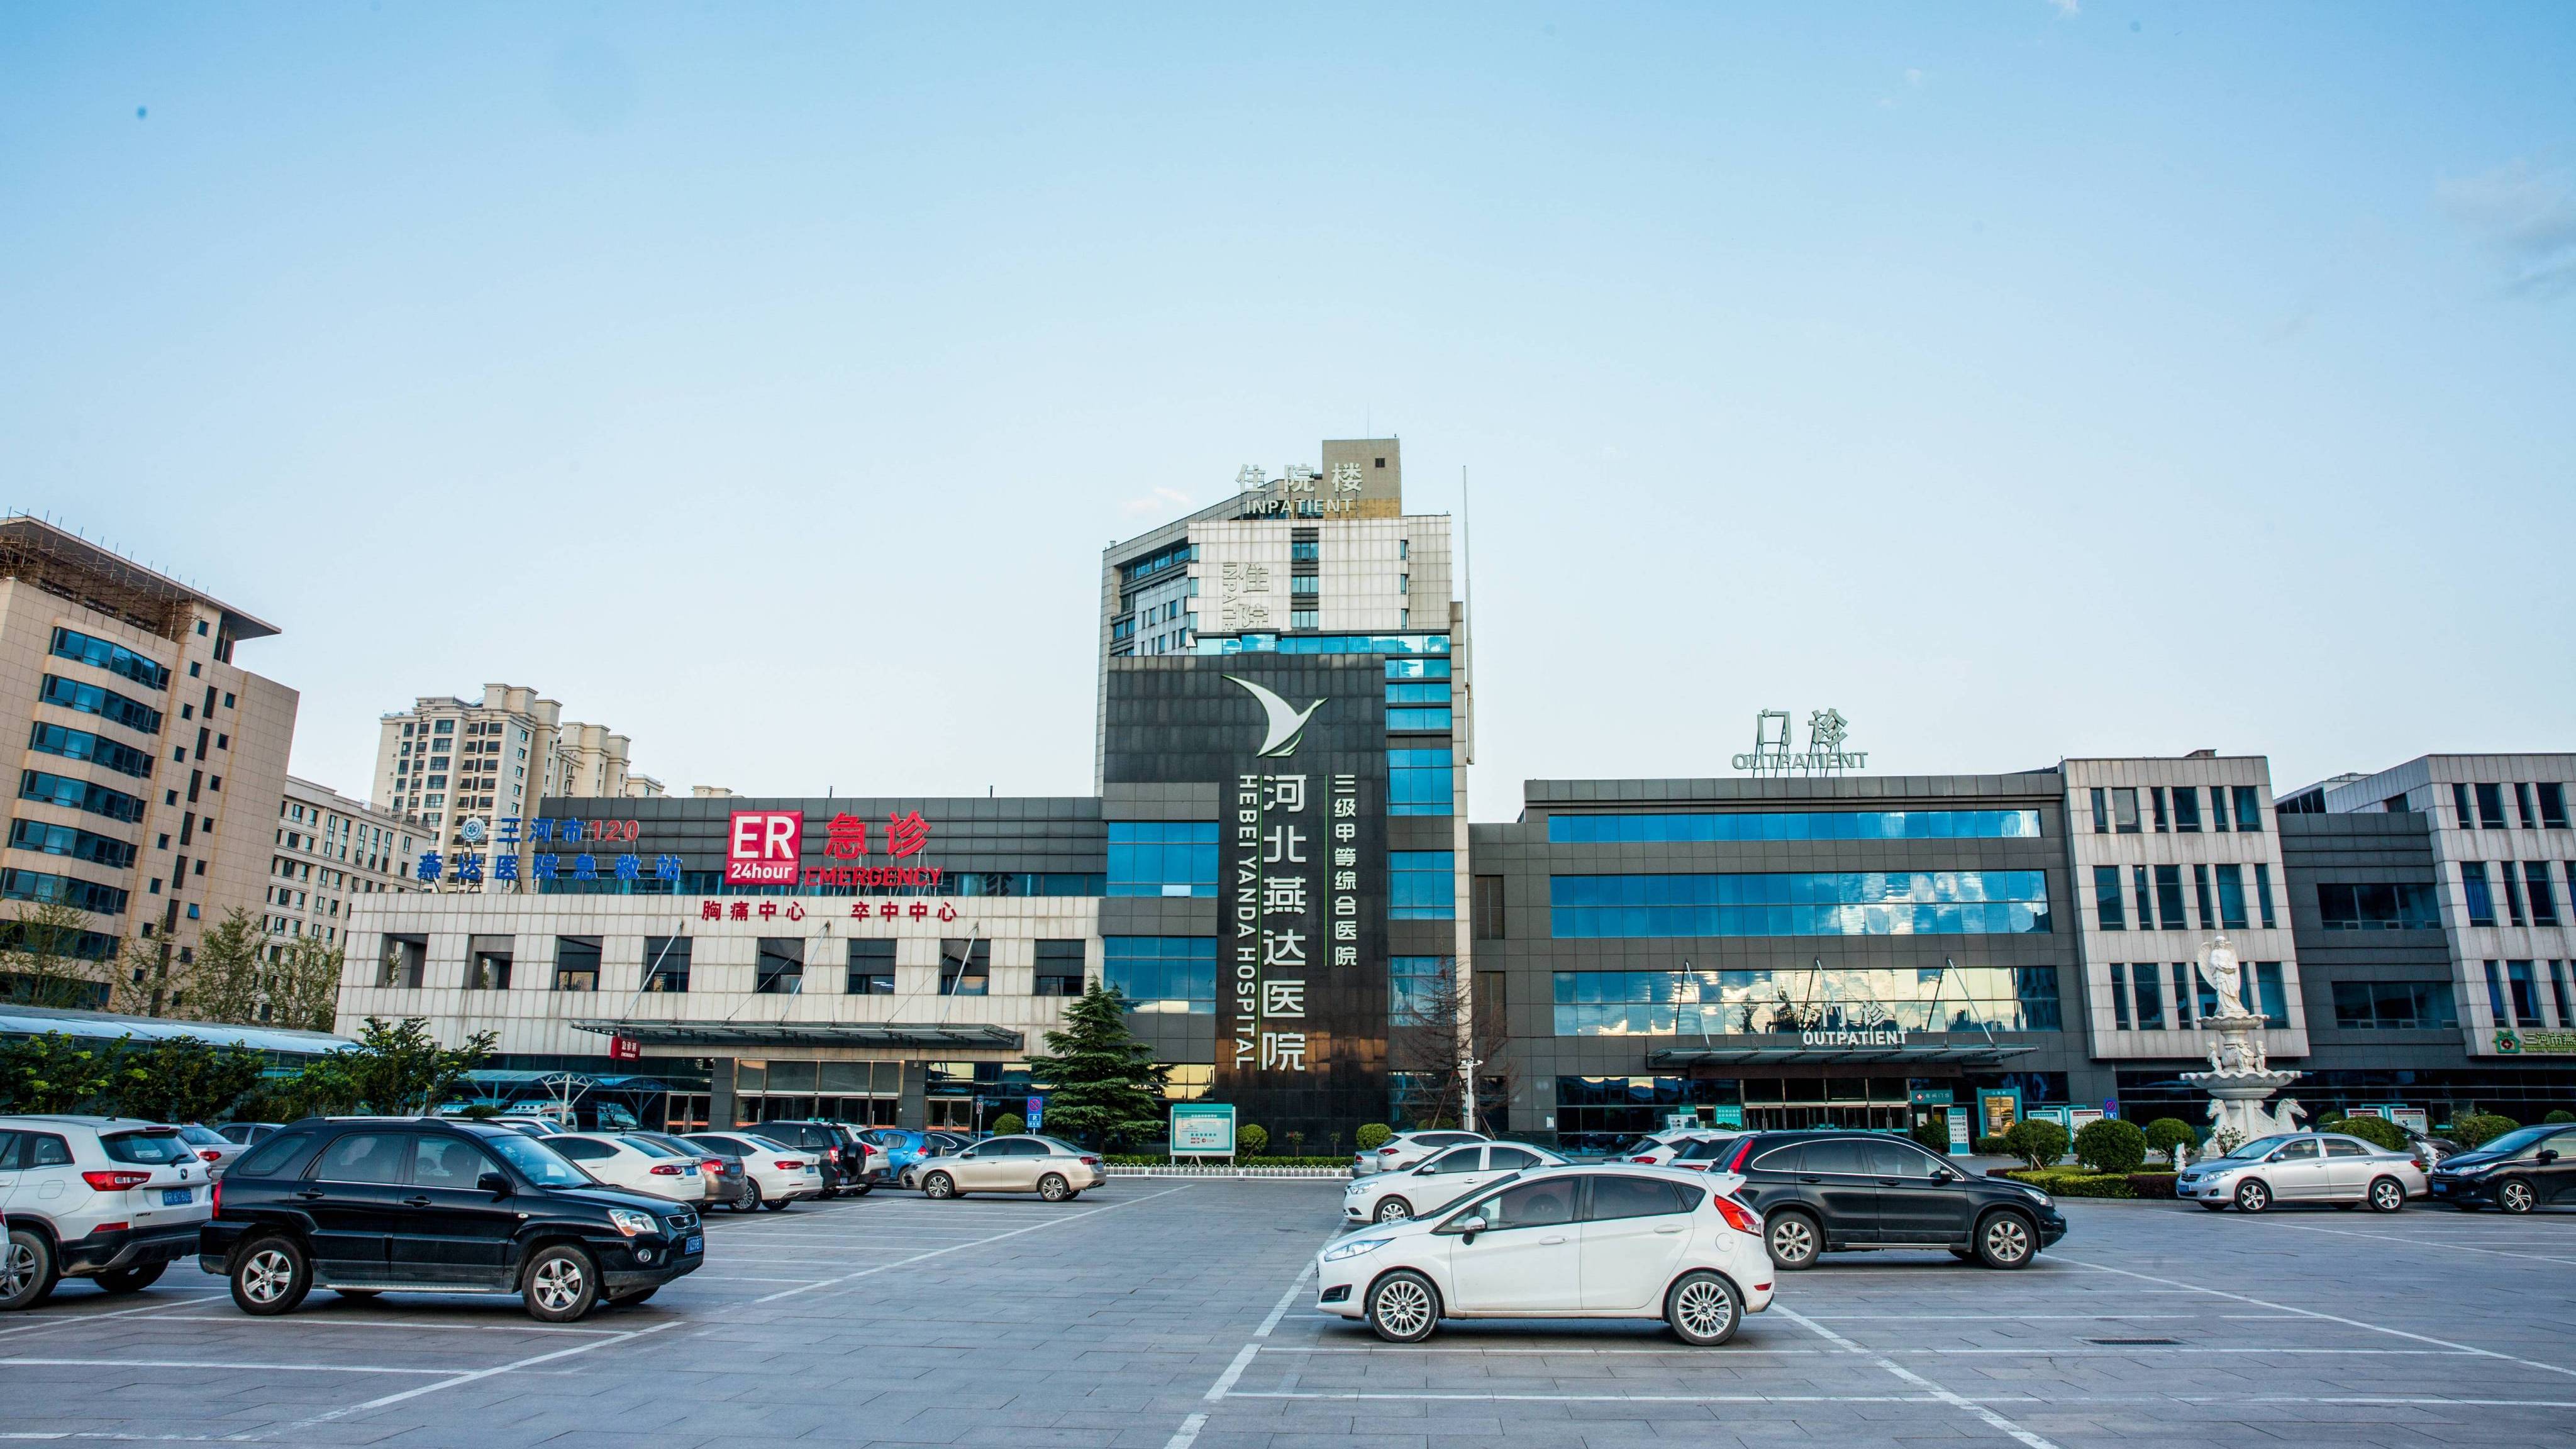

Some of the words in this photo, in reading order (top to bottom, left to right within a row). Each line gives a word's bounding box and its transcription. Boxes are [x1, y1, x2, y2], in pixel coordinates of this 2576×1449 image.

[1236, 463, 1362, 492] 住院楼
[1246, 498, 1353, 514] INPATIENT
[1238, 562, 1269, 628] 住院
[1757, 708, 1848, 747] 门诊
[1732, 752, 1868, 769] OUTPATIENT
[1238, 775, 1257, 847] HEBEI
[733, 816, 795, 859] ER
[824, 811, 932, 859] 急诊
[417, 853, 682, 881] 燕达医院急救站
[731, 863, 793, 879] 24hour
[804, 866, 943, 887] EMERGENCY
[1334, 774, 1357, 966] 三级甲等综合医院
[702, 901, 805, 922] 胸痛中心
[851, 901, 957, 923] 卒中中心
[1238, 855, 1257, 938] YANDA
[1262, 774, 1306, 1071] 河北燕达医院
[1236, 947, 1256, 1069] HOSPITAL
[1823, 1000, 1887, 1028] 门诊
[1802, 1030, 1907, 1045] OUTPATIENT
